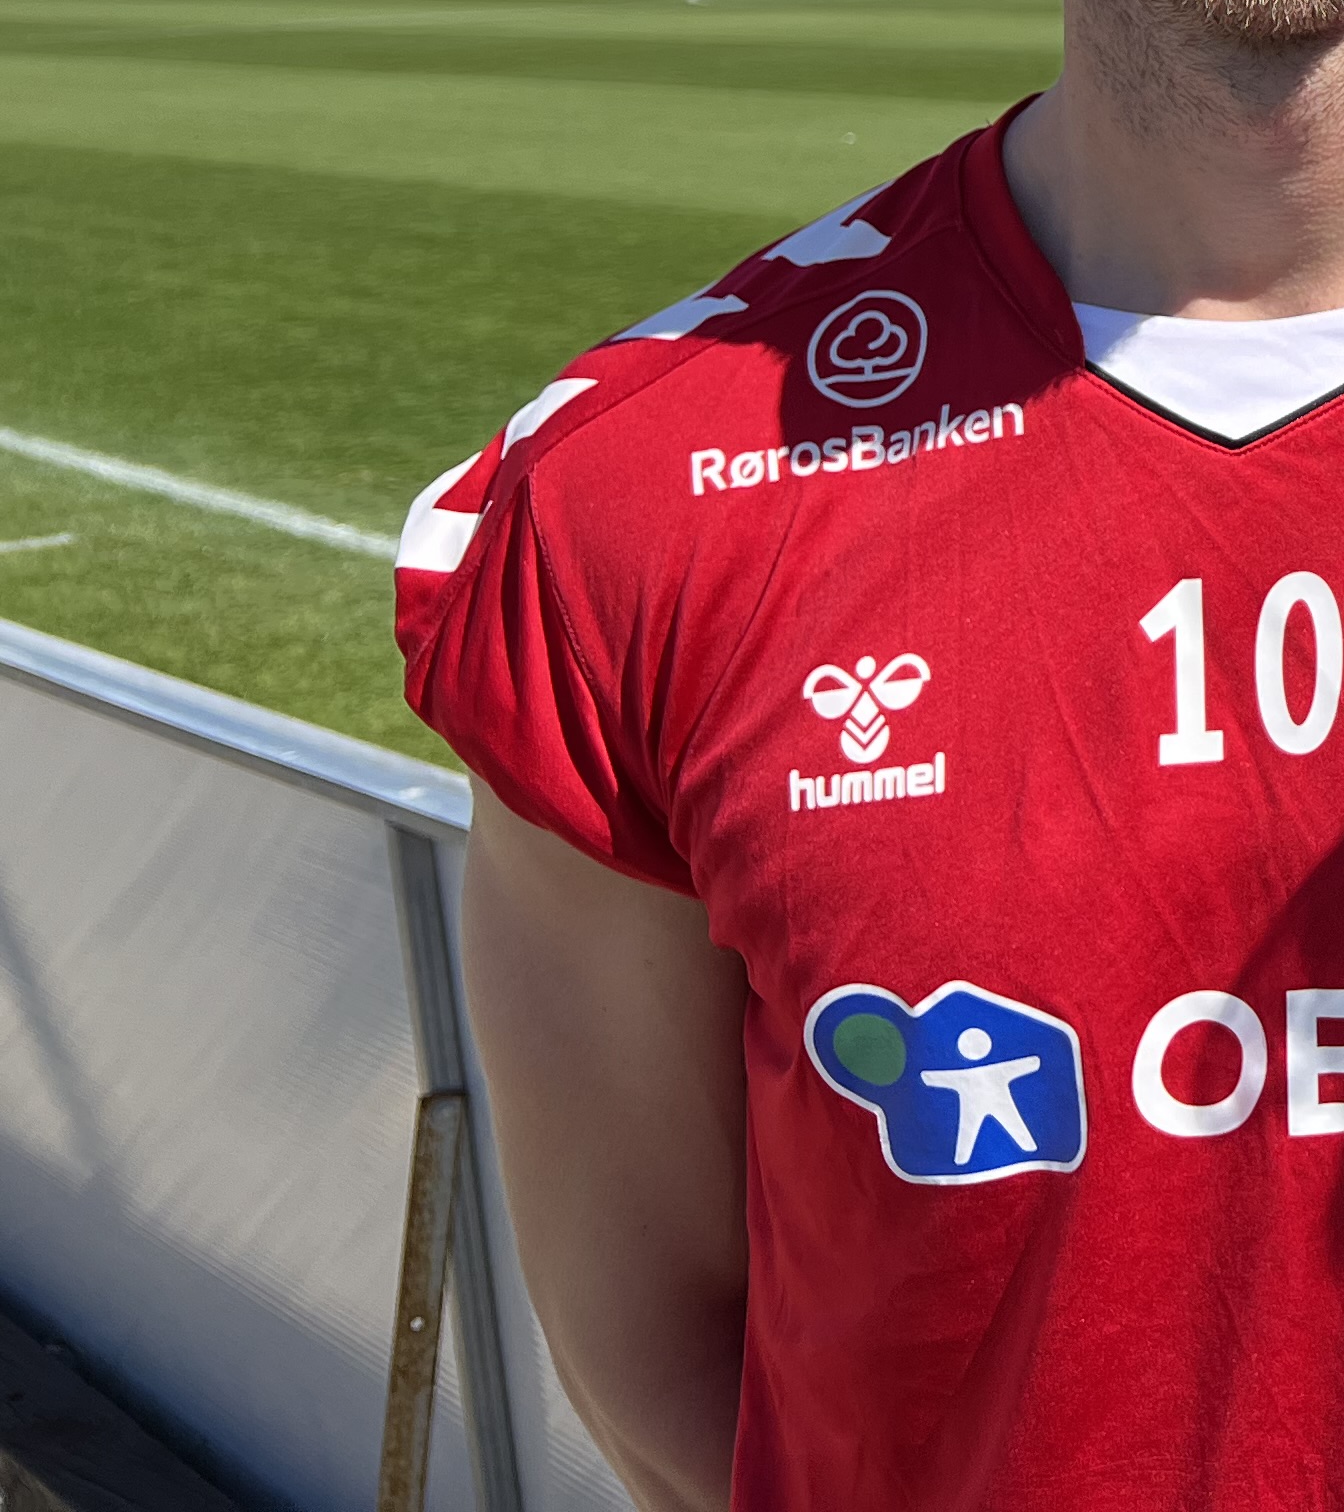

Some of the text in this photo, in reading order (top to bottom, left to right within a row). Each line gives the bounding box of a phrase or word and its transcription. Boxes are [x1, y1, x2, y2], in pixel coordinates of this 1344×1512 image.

[690, 402, 1025, 496] RørosBanken
[1139, 571, 1344, 767] 10
[789, 751, 945, 811] hummel
